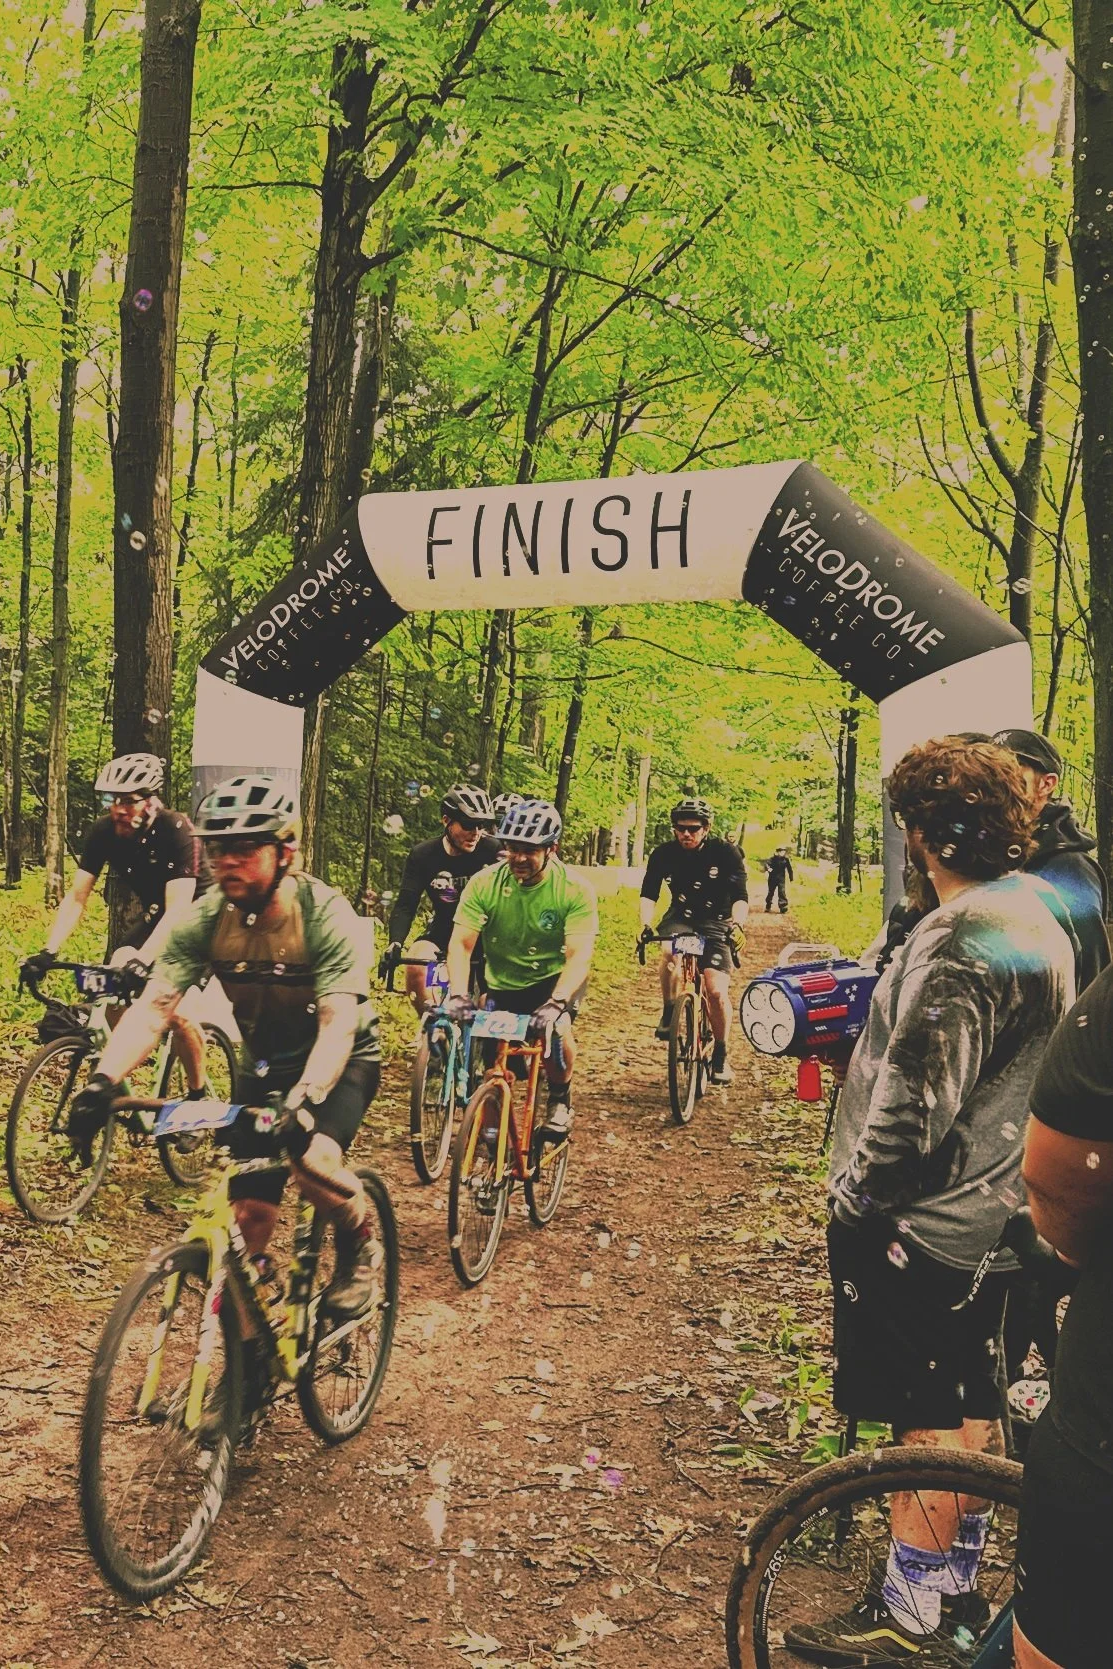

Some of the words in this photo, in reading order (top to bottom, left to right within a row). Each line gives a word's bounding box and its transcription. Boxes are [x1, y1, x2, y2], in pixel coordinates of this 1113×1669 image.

[426, 489, 692, 580] FINISH
[220, 546, 352, 670] VELODROME
[778, 507, 946, 655] VELODROME
[778, 557, 864, 631] COFFEE
[256, 606, 324, 671] COFFEE
[763, 1549, 787, 1581] 392
